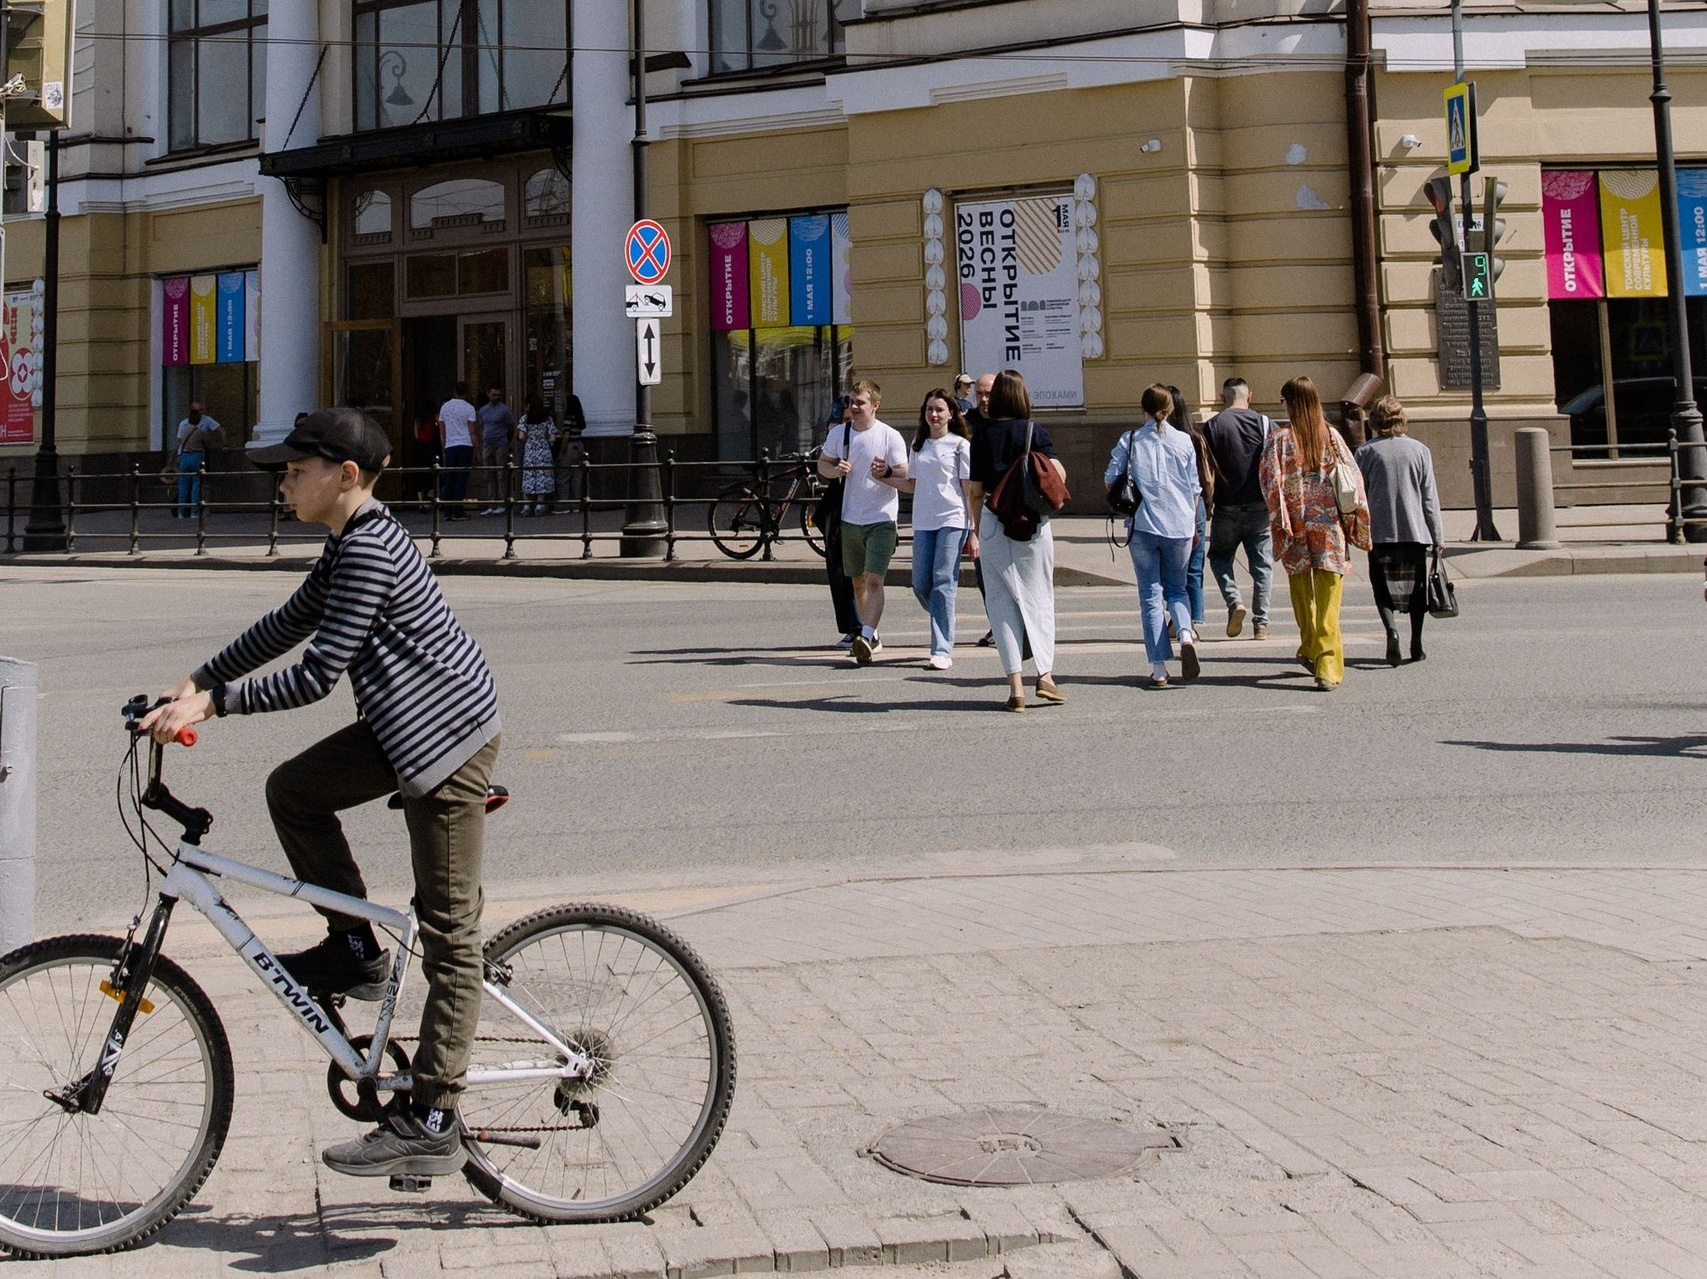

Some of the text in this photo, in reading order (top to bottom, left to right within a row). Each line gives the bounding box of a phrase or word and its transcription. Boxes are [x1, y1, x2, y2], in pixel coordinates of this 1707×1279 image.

[1052, 205, 1062, 228] 1
[1062, 204, 1070, 228] МАЯ
[1694, 206, 1706, 244] 12:00
[805, 248, 813, 280] 12:00
[958, 213, 975, 278] 2026
[979, 211, 997, 309] ВЕСНЫ
[1475, 256, 1486, 276] 9
[1559, 208, 1577, 292] ОТКРЫТИЕ
[1620, 208, 1633, 290] ТОМСКИЙ ЦЕНТР
[1629, 214, 1642, 290] СОВРЕМЕННОЙ
[1641, 238, 1651, 290] КУЛЬТУРЫ
[1697, 247, 1707, 278] МАЯ
[724, 254, 733, 324] ОТКРЫТИЕ
[806, 284, 814, 311] МАЯ
[1000, 208, 1021, 362] ОТКРЫТИЕ
[1032, 390, 1078, 400] ЭПОХАМИ
